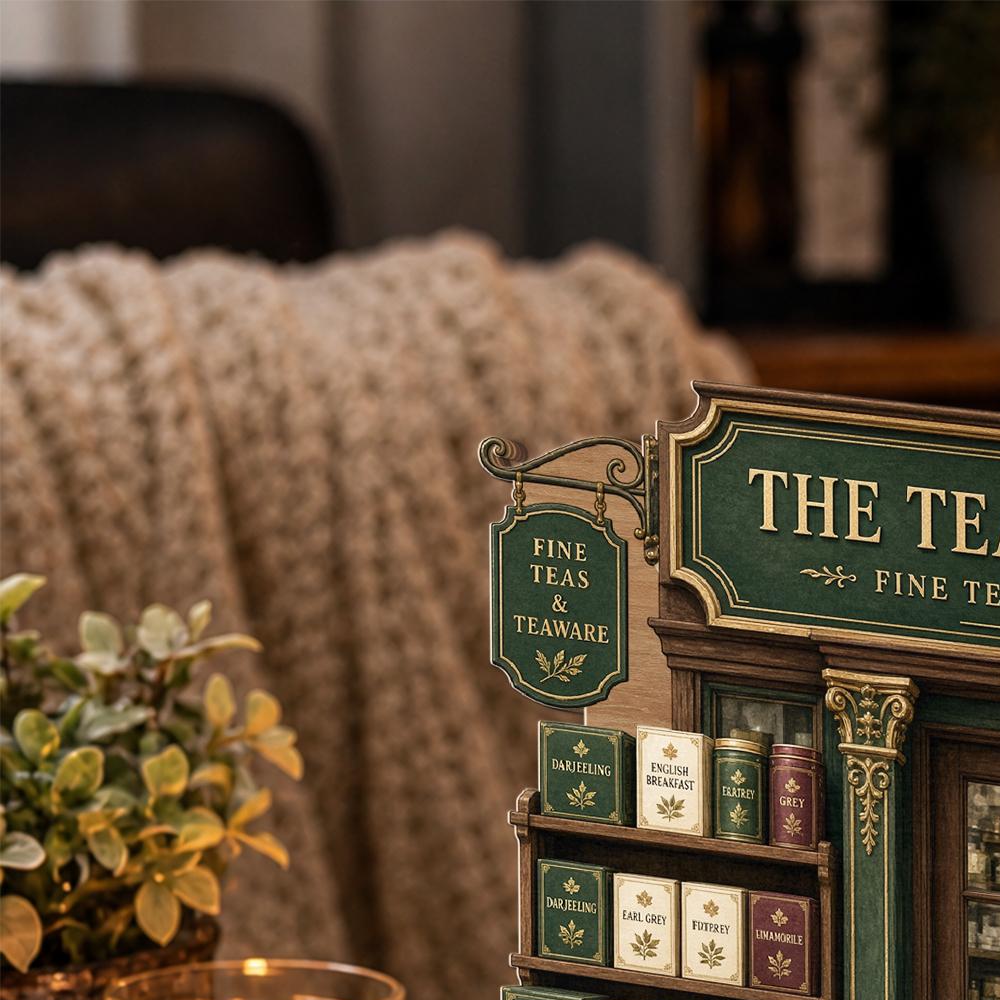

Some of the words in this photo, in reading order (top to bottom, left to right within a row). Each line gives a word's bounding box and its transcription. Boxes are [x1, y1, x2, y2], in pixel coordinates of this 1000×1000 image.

[748, 468, 882, 544] THE
[533, 538, 587, 562] FINE
[530, 565, 589, 588] TEAS
[875, 570, 948, 600] FINE
[552, 595, 568, 613] &
[513, 615, 609, 644] TEAWARE
[552, 758, 611, 777] DARJEELING
[651, 762, 689, 777] ENGLISH
[646, 776, 694, 791] BREAKFAST
[780, 796, 805, 808] GREY
[546, 896, 596, 914] DARJEELING
[622, 910, 643, 923] EARL
[645, 913, 667, 926] GREY
